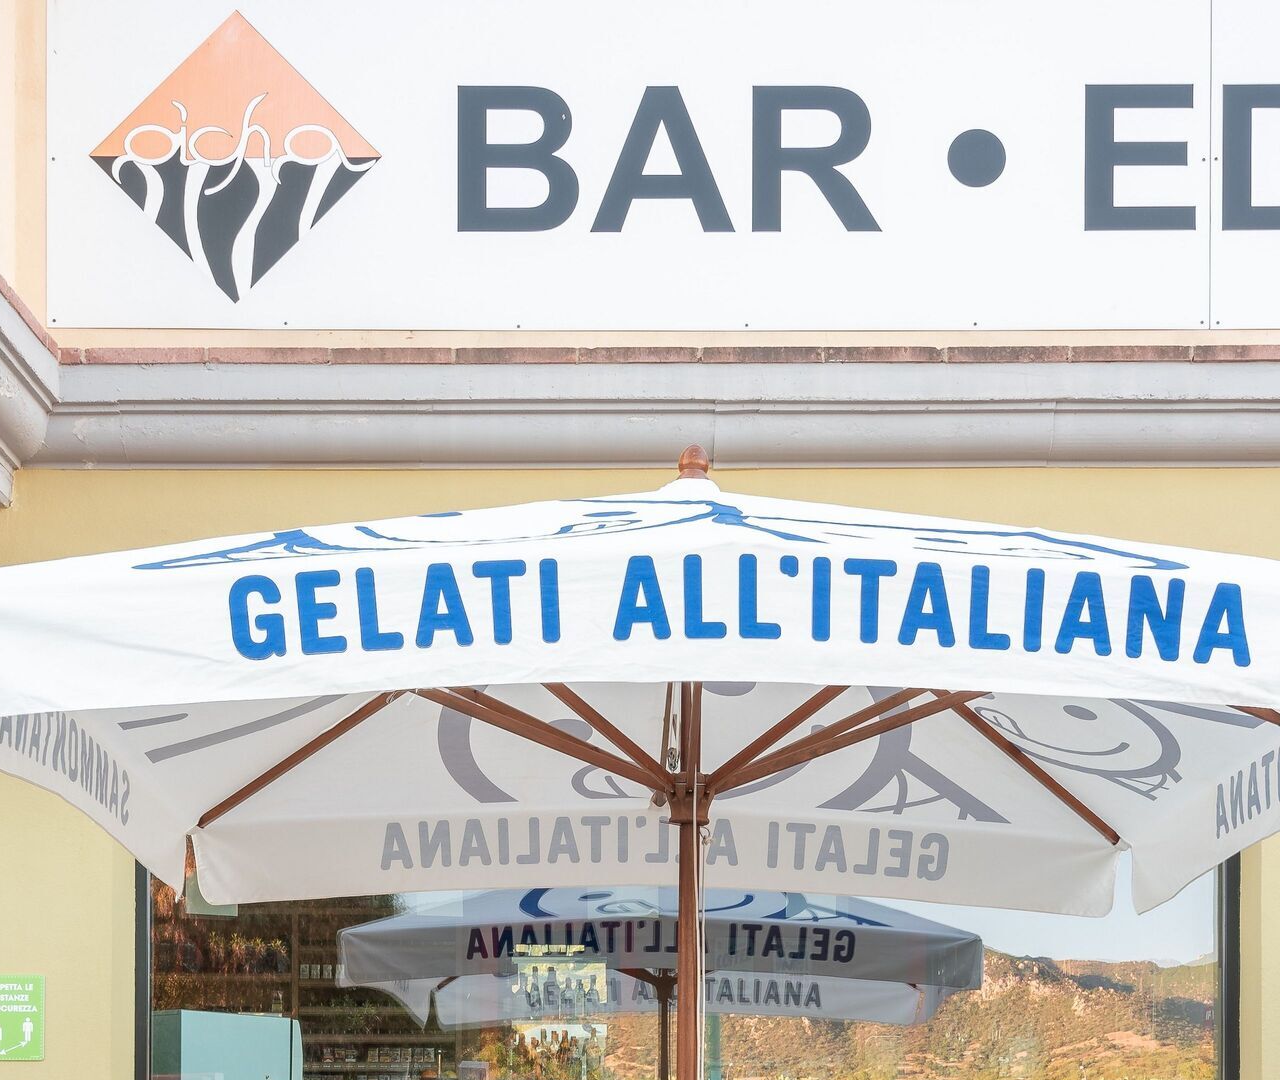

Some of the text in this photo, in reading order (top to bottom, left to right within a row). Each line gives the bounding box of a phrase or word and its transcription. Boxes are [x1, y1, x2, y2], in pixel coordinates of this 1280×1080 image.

[456, 84, 883, 233] BAR
[228, 553, 1252, 667] GELATI ALL'ITALIANA
[25, 983, 34, 991] LE
